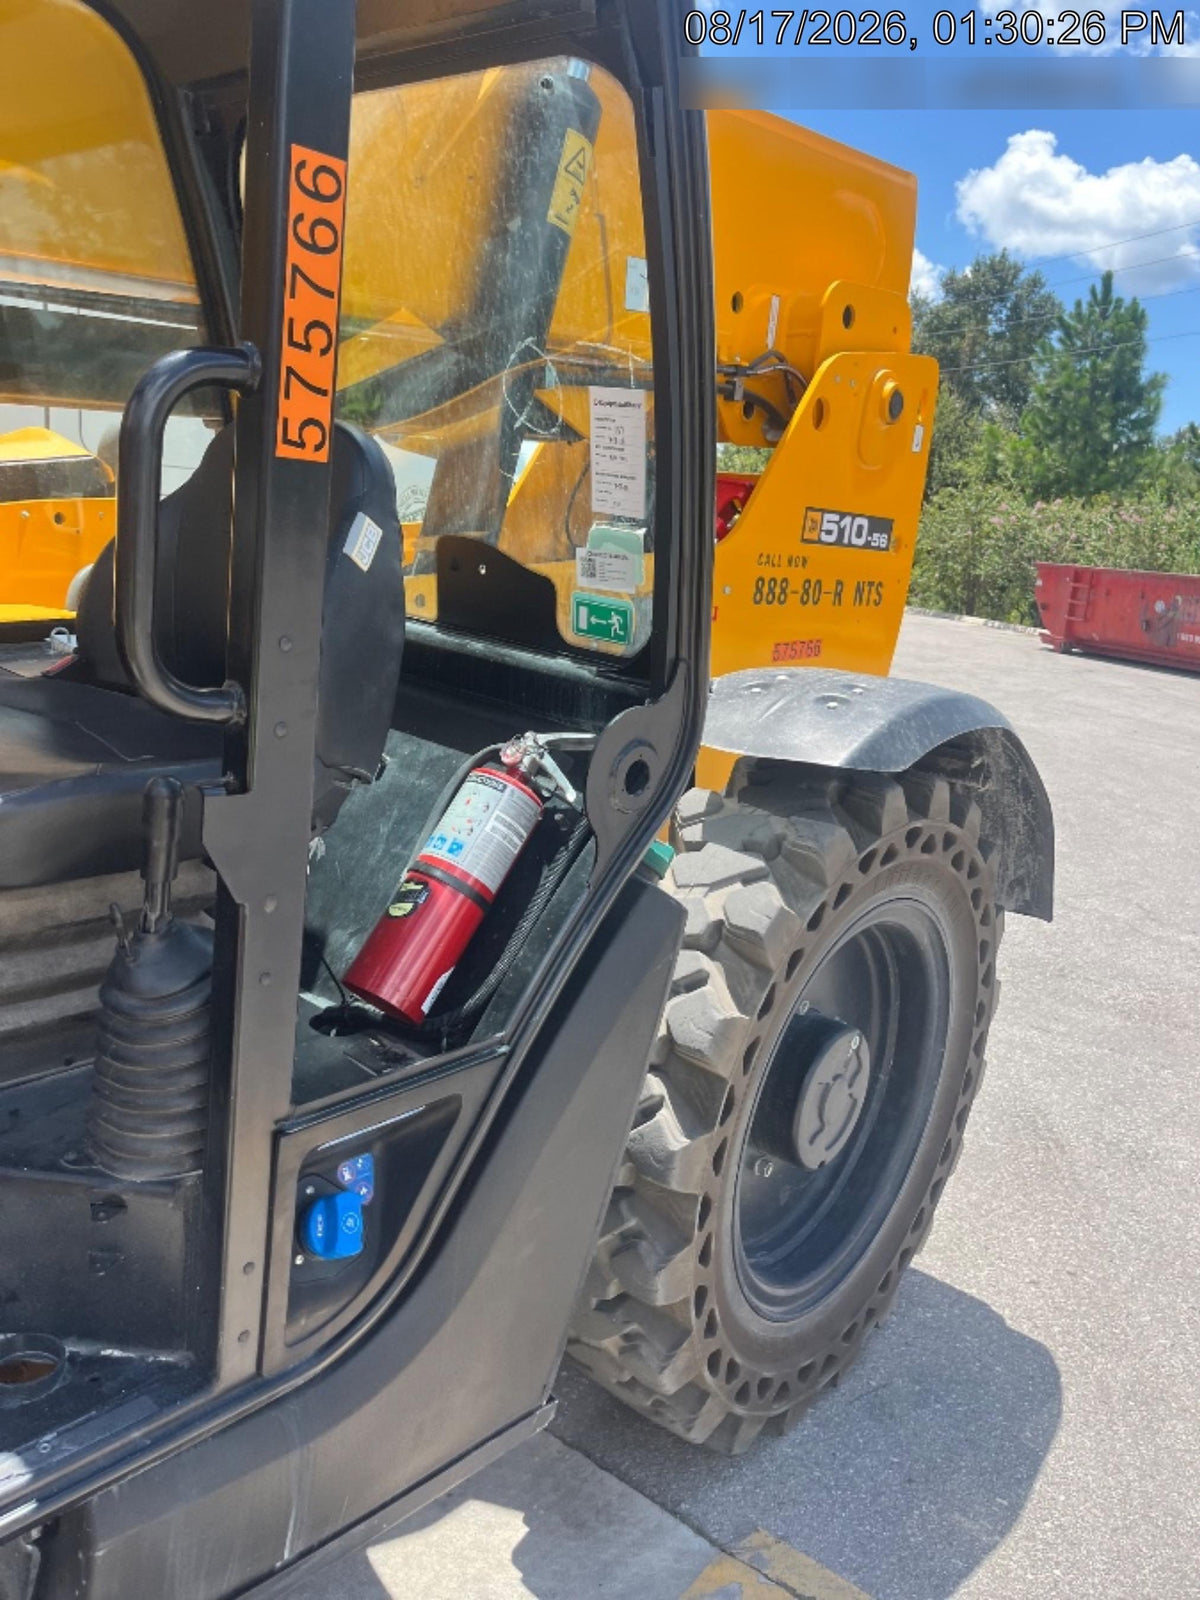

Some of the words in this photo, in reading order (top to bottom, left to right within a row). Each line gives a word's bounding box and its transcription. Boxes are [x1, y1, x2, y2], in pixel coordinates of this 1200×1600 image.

[282, 159, 342, 453] 575766
[757, 553, 782, 568] CALL
[753, 576, 844, 606] 888-80-R
[853, 580, 883, 606] NTS
